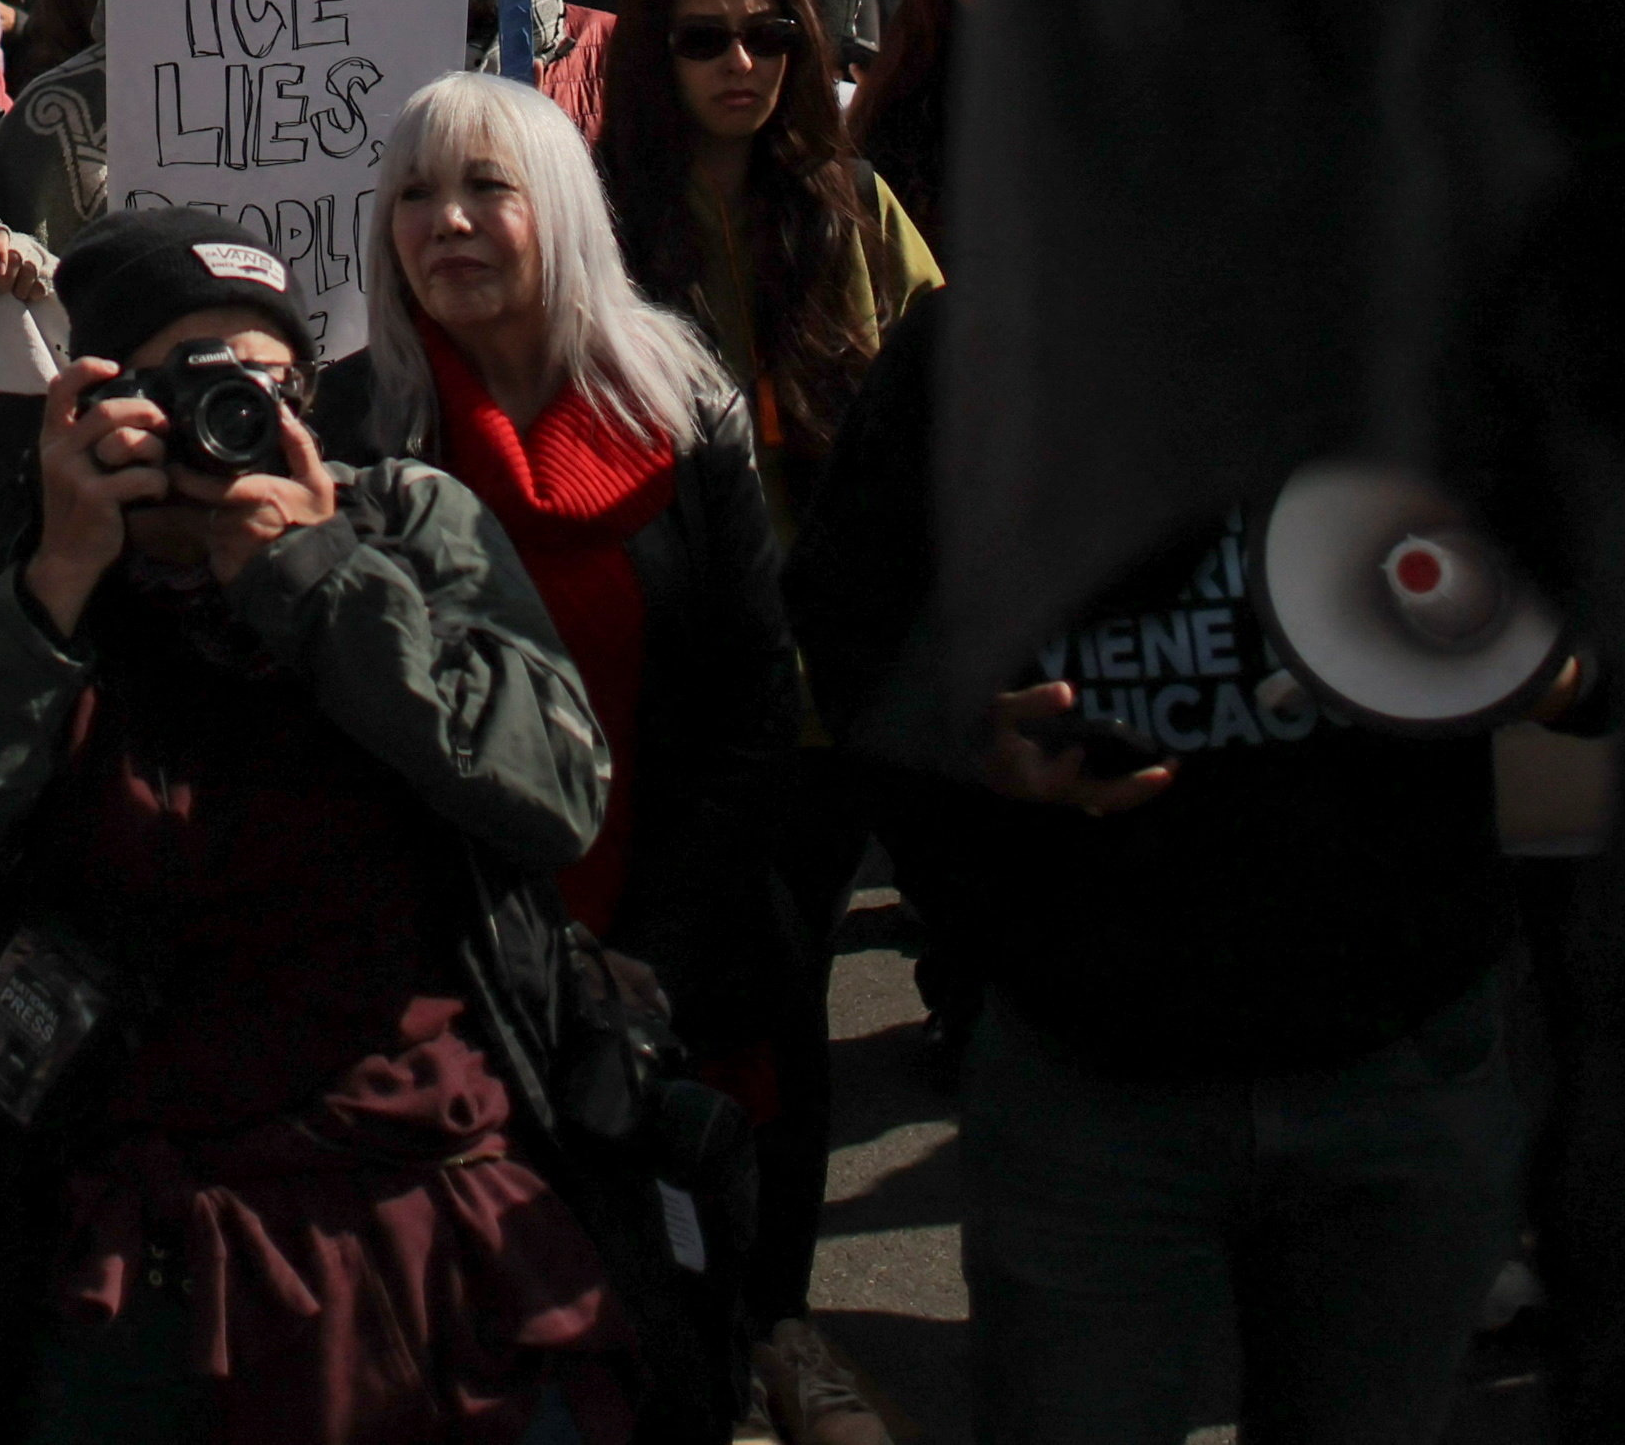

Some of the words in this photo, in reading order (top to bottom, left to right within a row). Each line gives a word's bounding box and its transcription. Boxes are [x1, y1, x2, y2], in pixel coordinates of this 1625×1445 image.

[154, 56, 386, 171] LIES,
[125, 188, 376, 296] OPL
[216, 246, 273, 271] VANS
[187, 347, 230, 366] Canon
